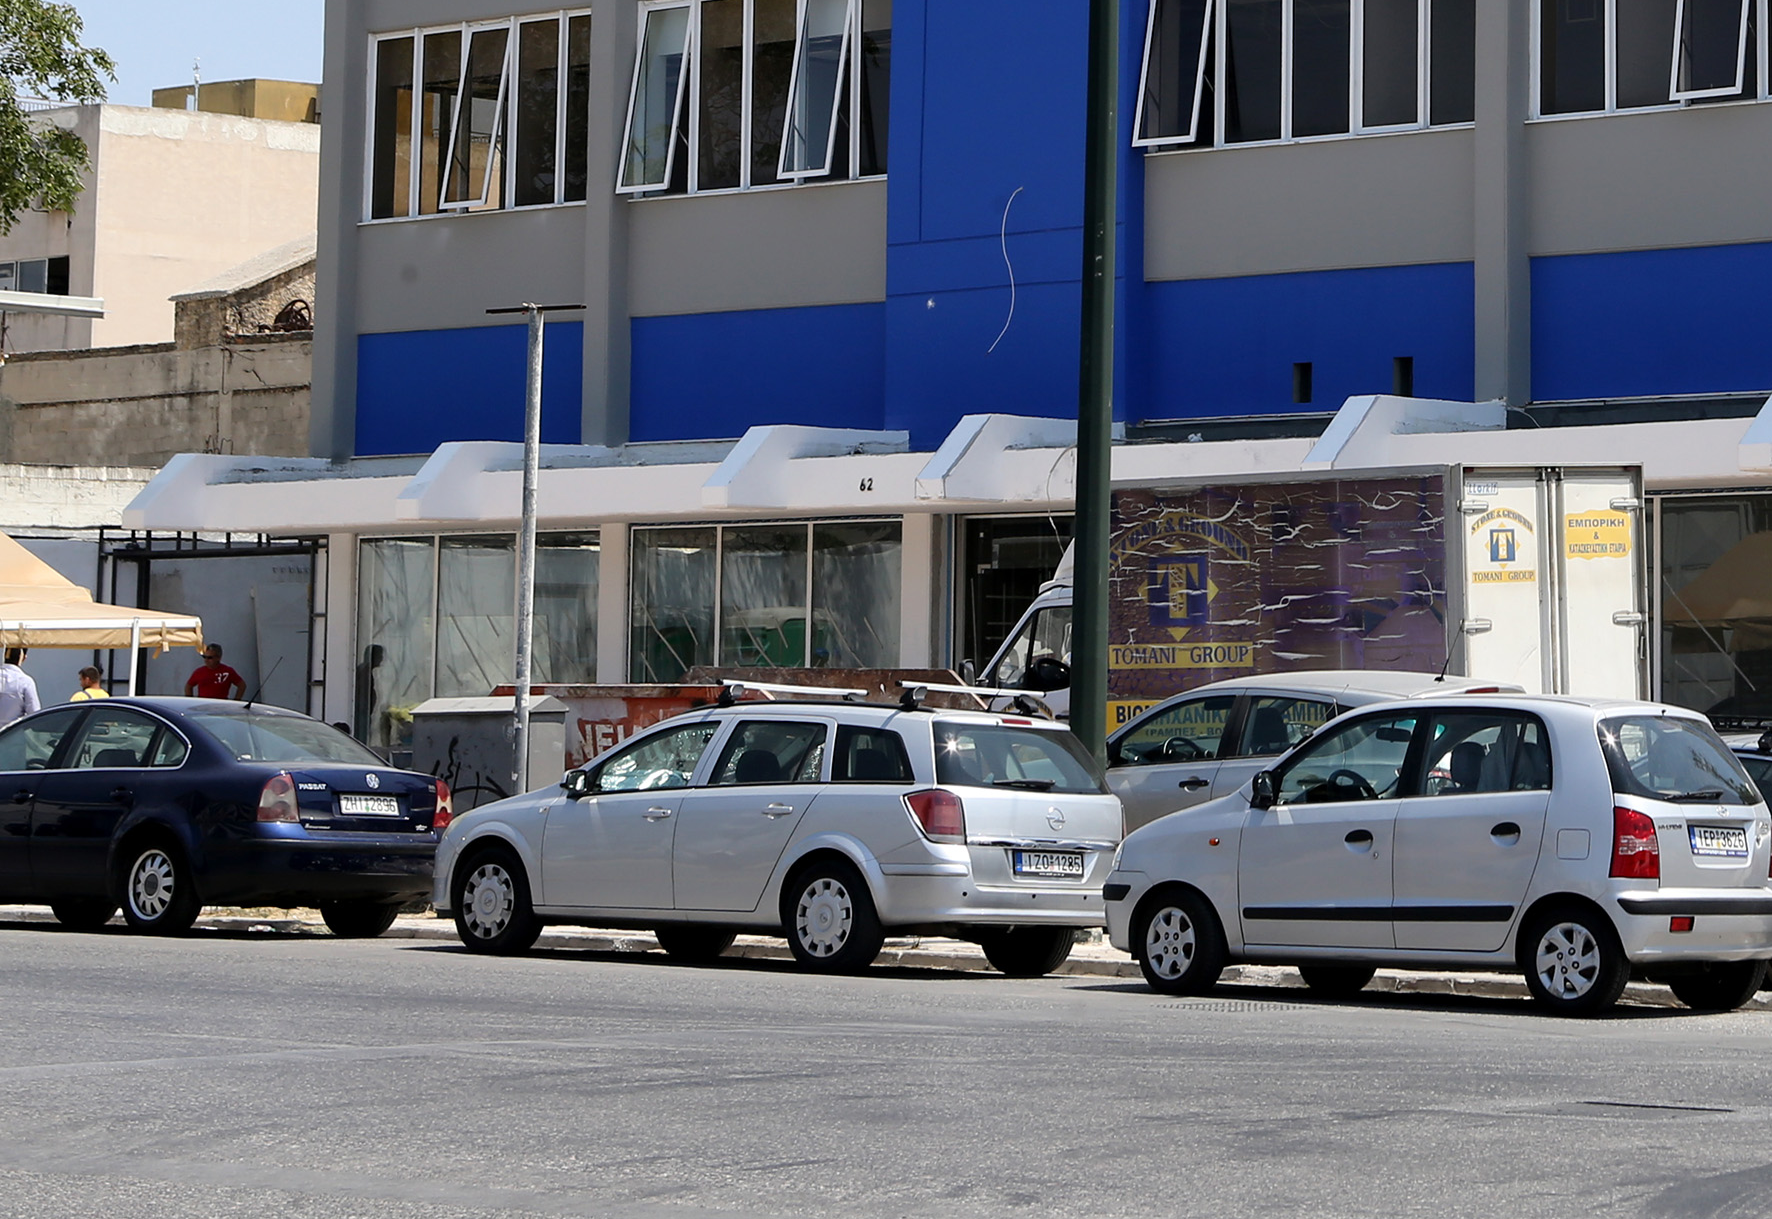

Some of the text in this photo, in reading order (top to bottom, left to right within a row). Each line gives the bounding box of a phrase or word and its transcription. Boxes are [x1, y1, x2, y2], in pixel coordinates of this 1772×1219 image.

[859, 477, 874, 492] 62
[1568, 519, 1625, 528] ΕΜΠΟΡΙΚΗ
[1593, 531, 1599, 540] &
[1473, 571, 1534, 581] TOMANI GROUP
[1112, 645, 1249, 665] TOMANI GROUP
[298, 783, 326, 791] PASSAT
